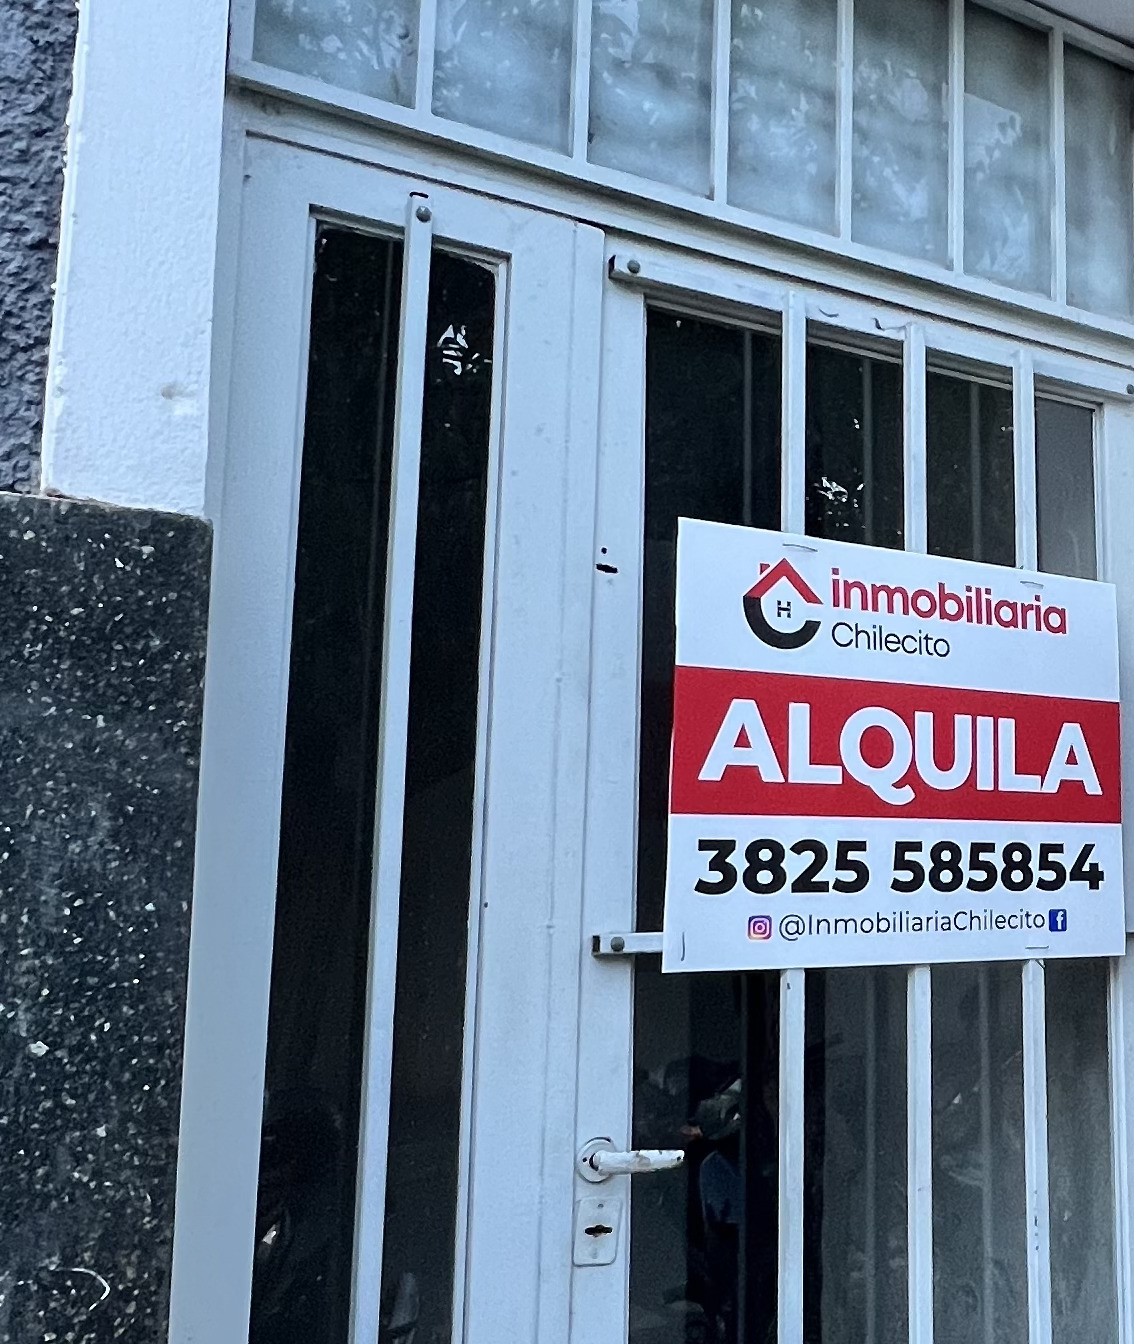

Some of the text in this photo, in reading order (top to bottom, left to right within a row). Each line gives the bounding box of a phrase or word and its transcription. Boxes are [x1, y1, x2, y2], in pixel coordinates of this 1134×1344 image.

[831, 567, 1068, 635] inmobiliaria
[830, 621, 951, 658] Chilecito
[698, 697, 1103, 806] ALQUILA
[693, 837, 1104, 894] 3825 585854
[778, 908, 1046, 942] @InmobiliariaChilecito
